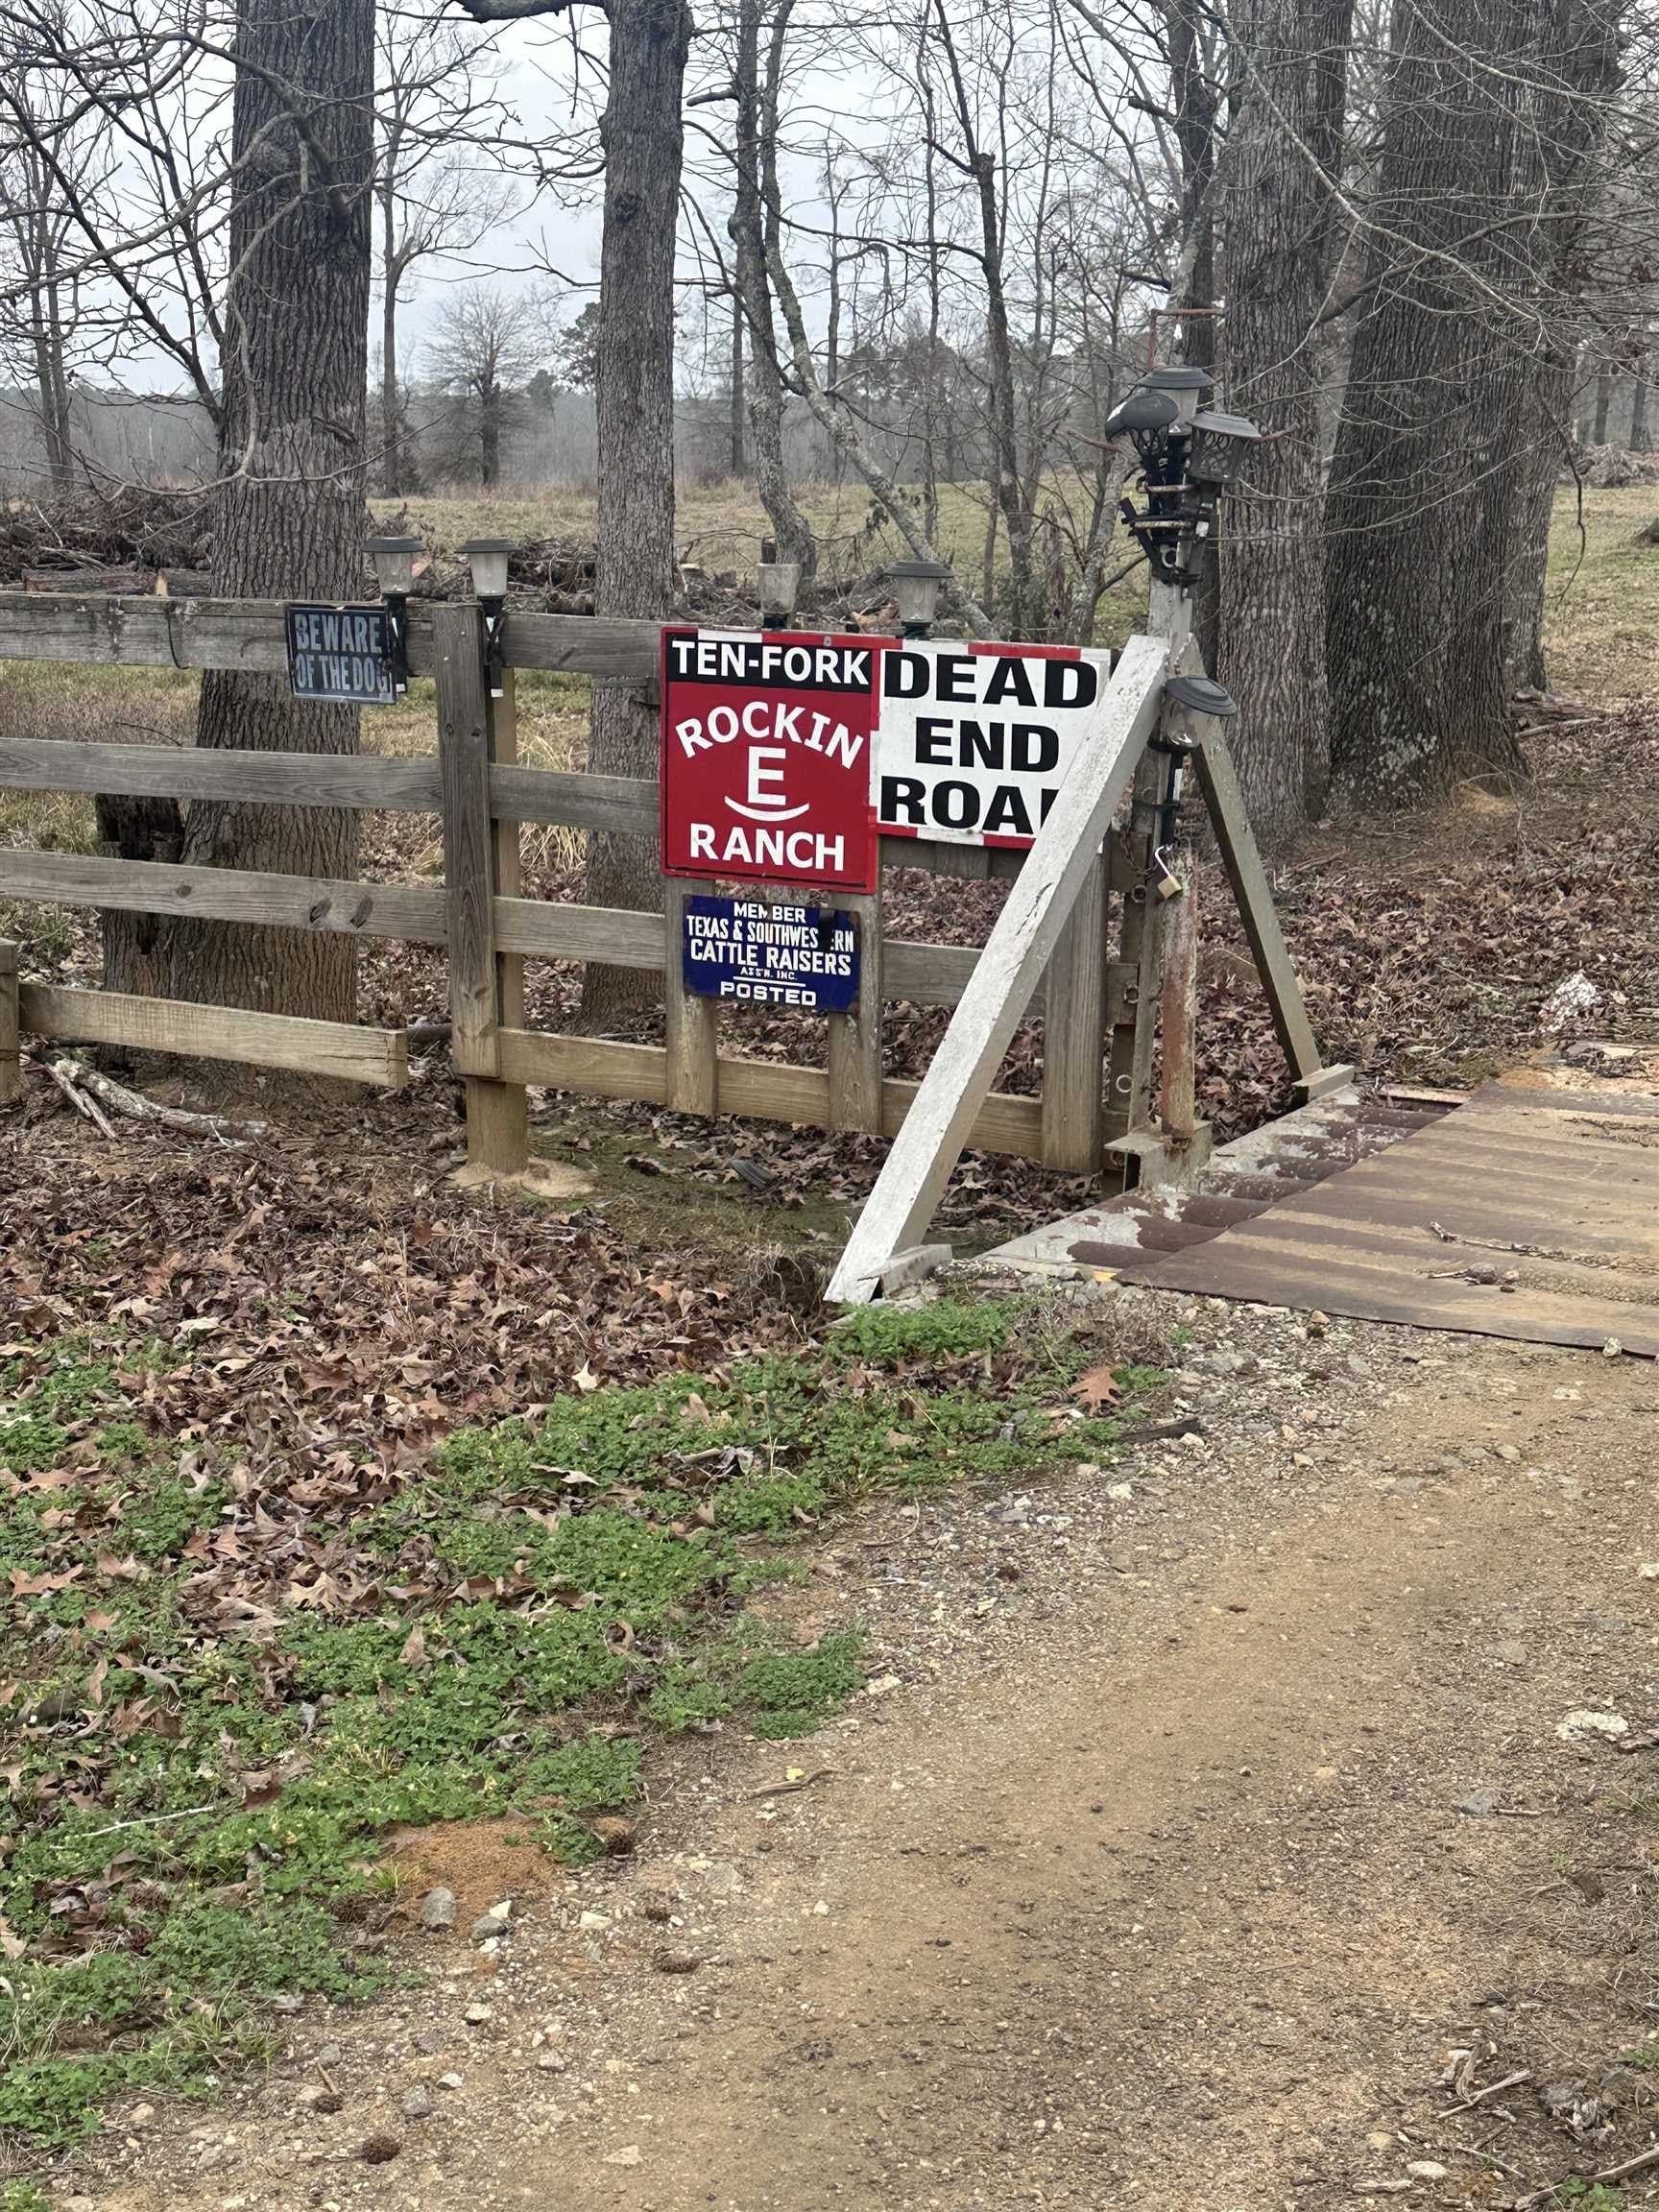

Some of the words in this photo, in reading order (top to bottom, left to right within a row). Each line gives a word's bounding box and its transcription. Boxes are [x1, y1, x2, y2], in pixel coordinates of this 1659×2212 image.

[295, 613, 382, 654] BEWARE
[296, 653, 315, 688] OF
[319, 655, 350, 690] THE
[672, 641, 869, 685] TEN-FORK
[884, 651, 1097, 709] DEAD
[676, 702, 863, 769] ROCKIN
[915, 716, 1059, 773] END
[748, 746, 786, 805] E
[880, 775, 1060, 834] ROA
[689, 824, 844, 871] RANCH
[686, 915, 729, 940] TEXAS
[733, 920, 743, 942] &
[747, 922, 854, 952] SOUTHWESRN
[690, 939, 758, 967] CATTLE
[766, 947, 852, 975] RAISERS
[776, 971, 798, 980] INC.
[720, 981, 817, 1006] POSTED
